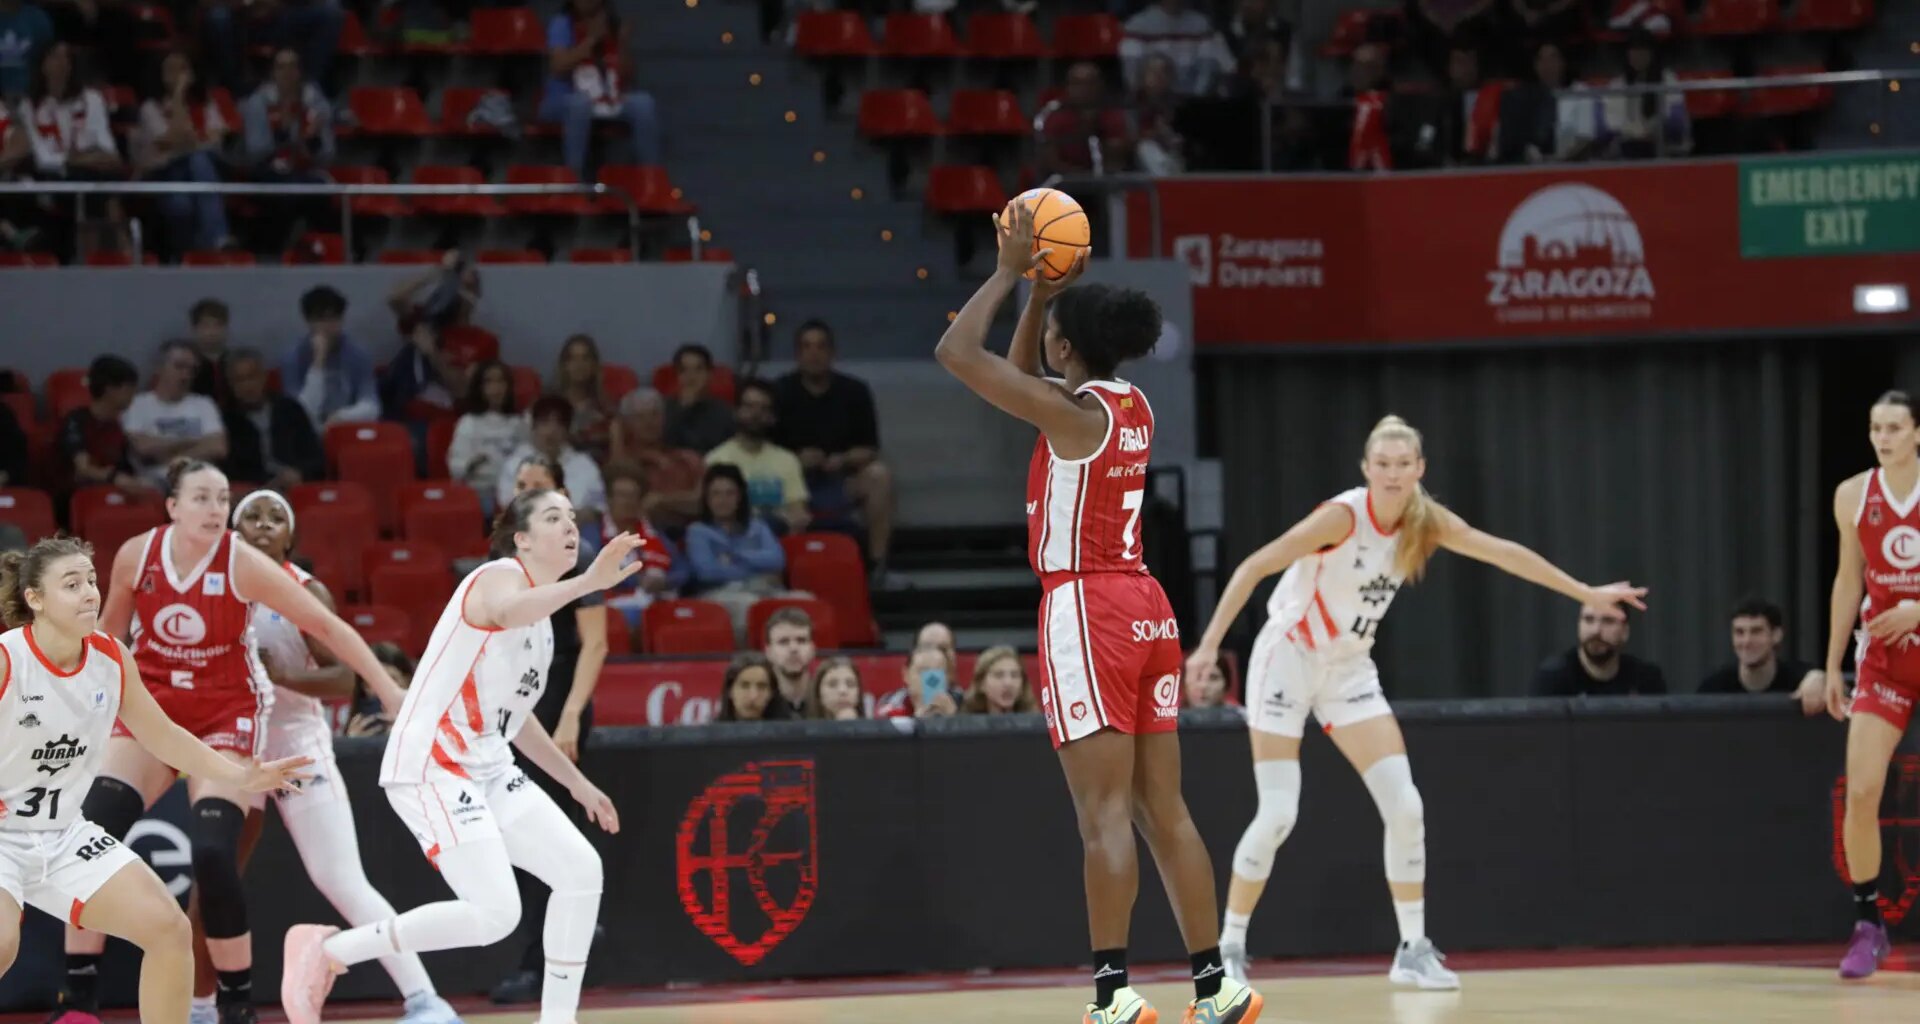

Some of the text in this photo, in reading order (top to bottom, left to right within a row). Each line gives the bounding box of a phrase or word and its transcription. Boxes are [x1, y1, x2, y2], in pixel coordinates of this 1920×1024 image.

[1751, 163, 1920, 207] EMERGENCY
[1805, 208, 1867, 245] EXIT
[1219, 233, 1323, 266] Zaragoza
[1486, 264, 1655, 305] ZARAGOZA
[1122, 489, 1145, 560] 7
[16, 787, 62, 820] 31
